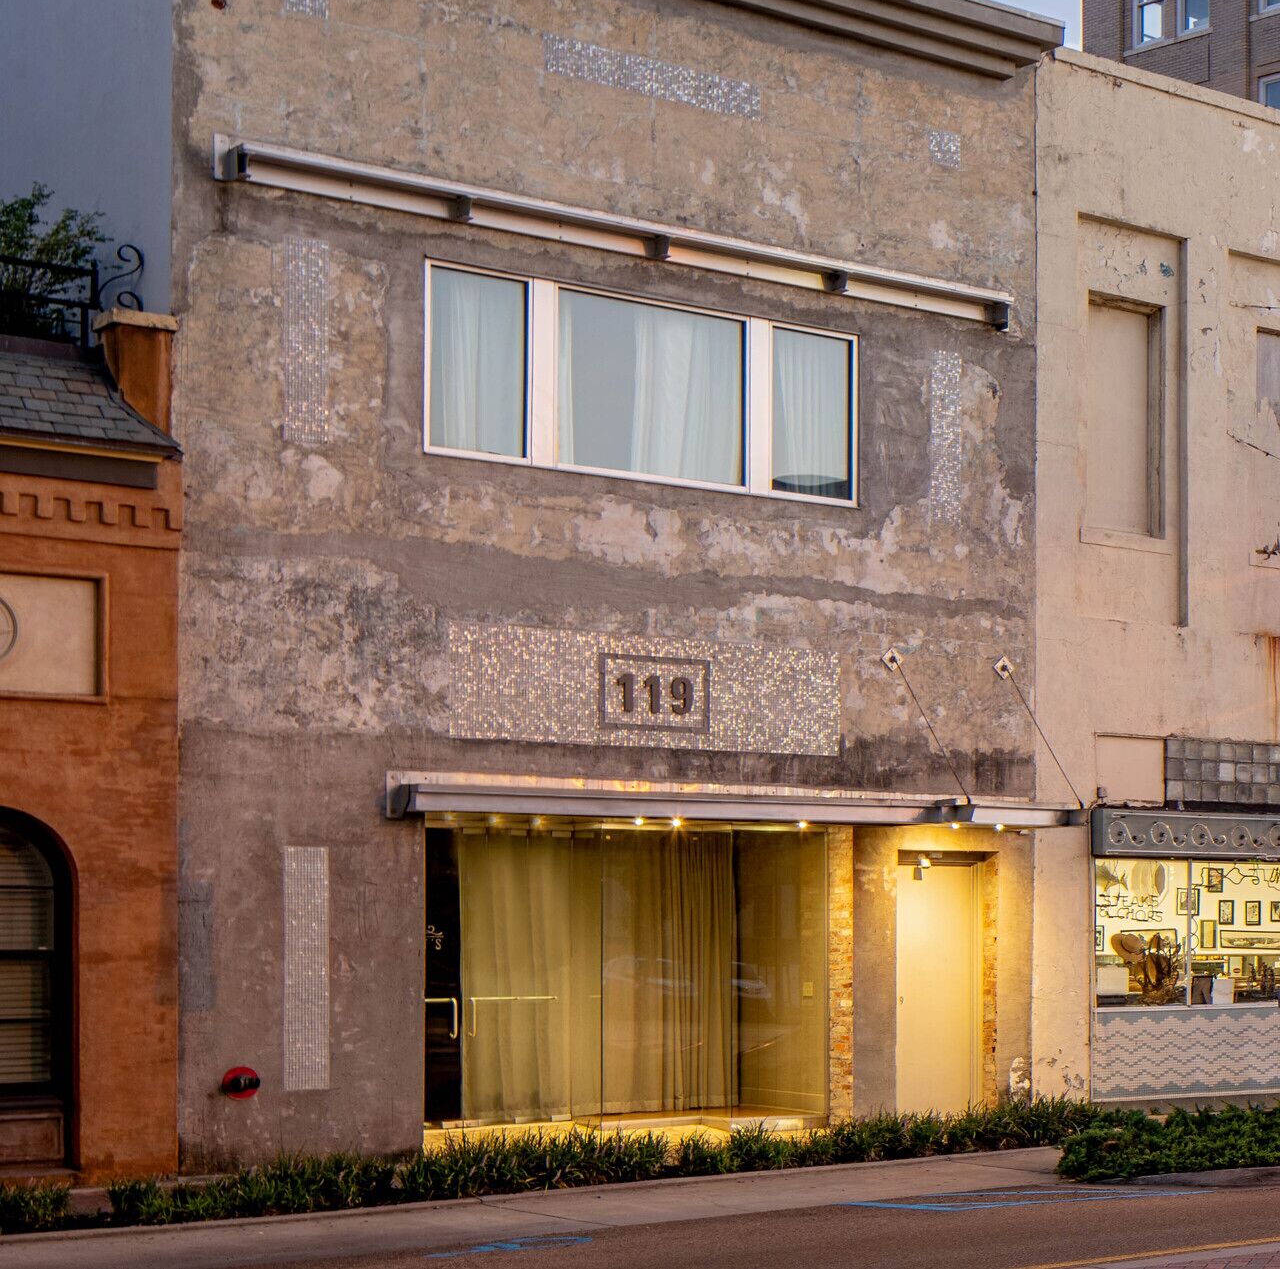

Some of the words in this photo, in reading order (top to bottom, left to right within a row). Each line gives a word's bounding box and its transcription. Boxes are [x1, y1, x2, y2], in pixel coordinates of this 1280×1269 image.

[616, 673, 695, 716] 119
[1097, 893, 1159, 907] STEAKS
[1117, 906, 1163, 922] CHOPS
